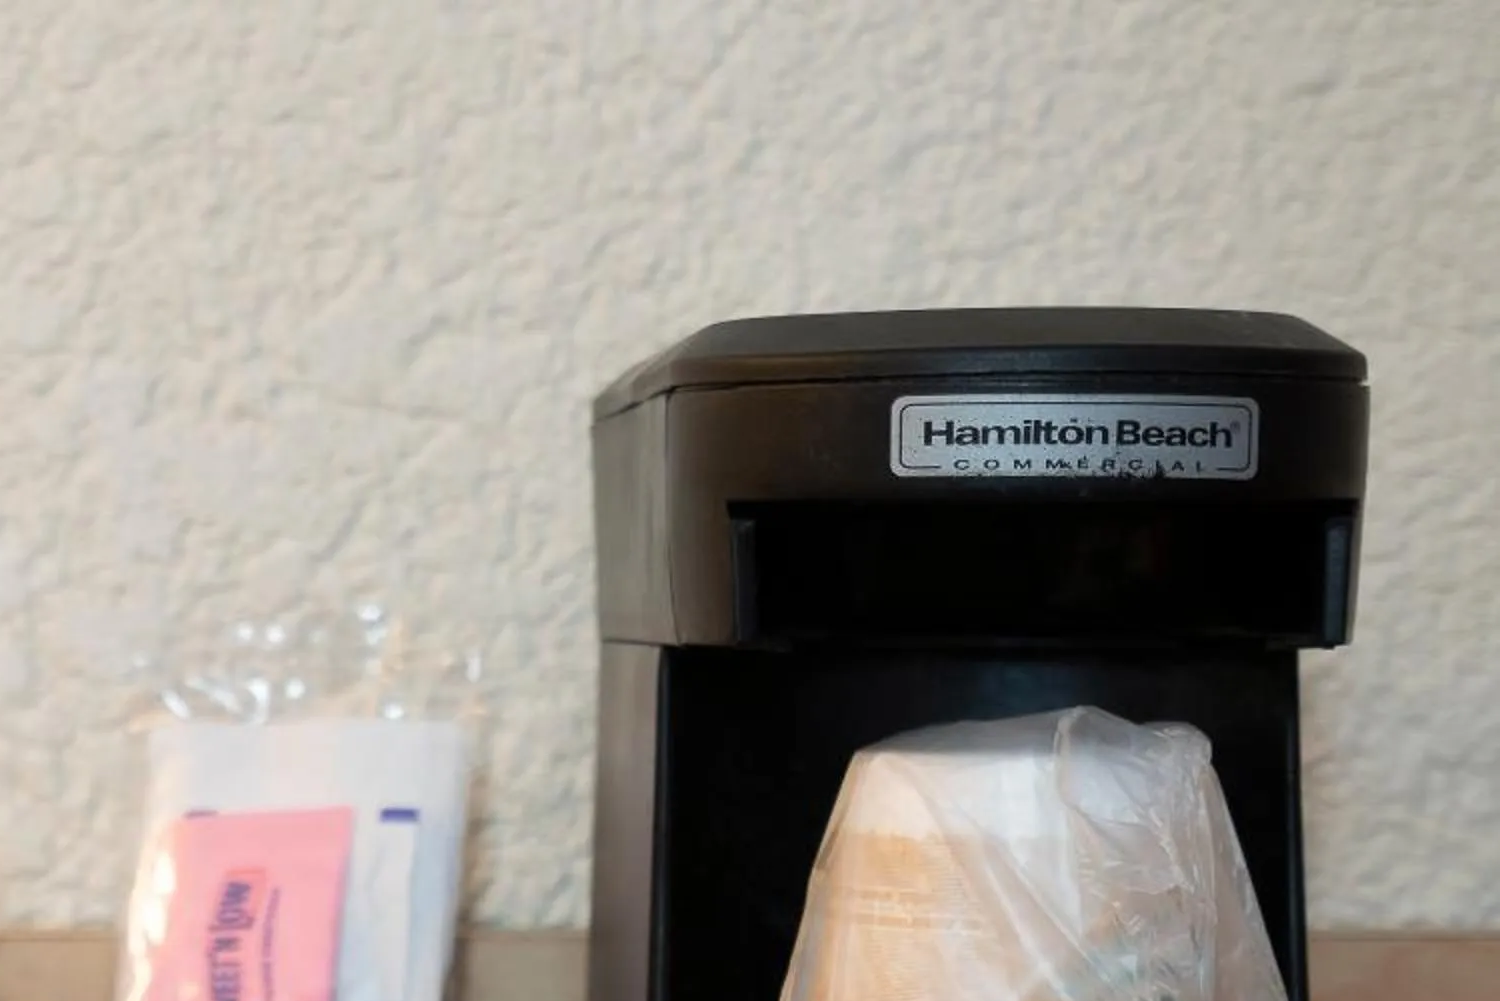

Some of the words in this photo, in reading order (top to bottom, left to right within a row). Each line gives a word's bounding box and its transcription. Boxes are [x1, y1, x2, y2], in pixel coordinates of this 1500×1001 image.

[922, 418, 1108, 447] Hamilton
[1115, 418, 1233, 448] Beach
[953, 456, 1205, 474] COMMERCIAL
